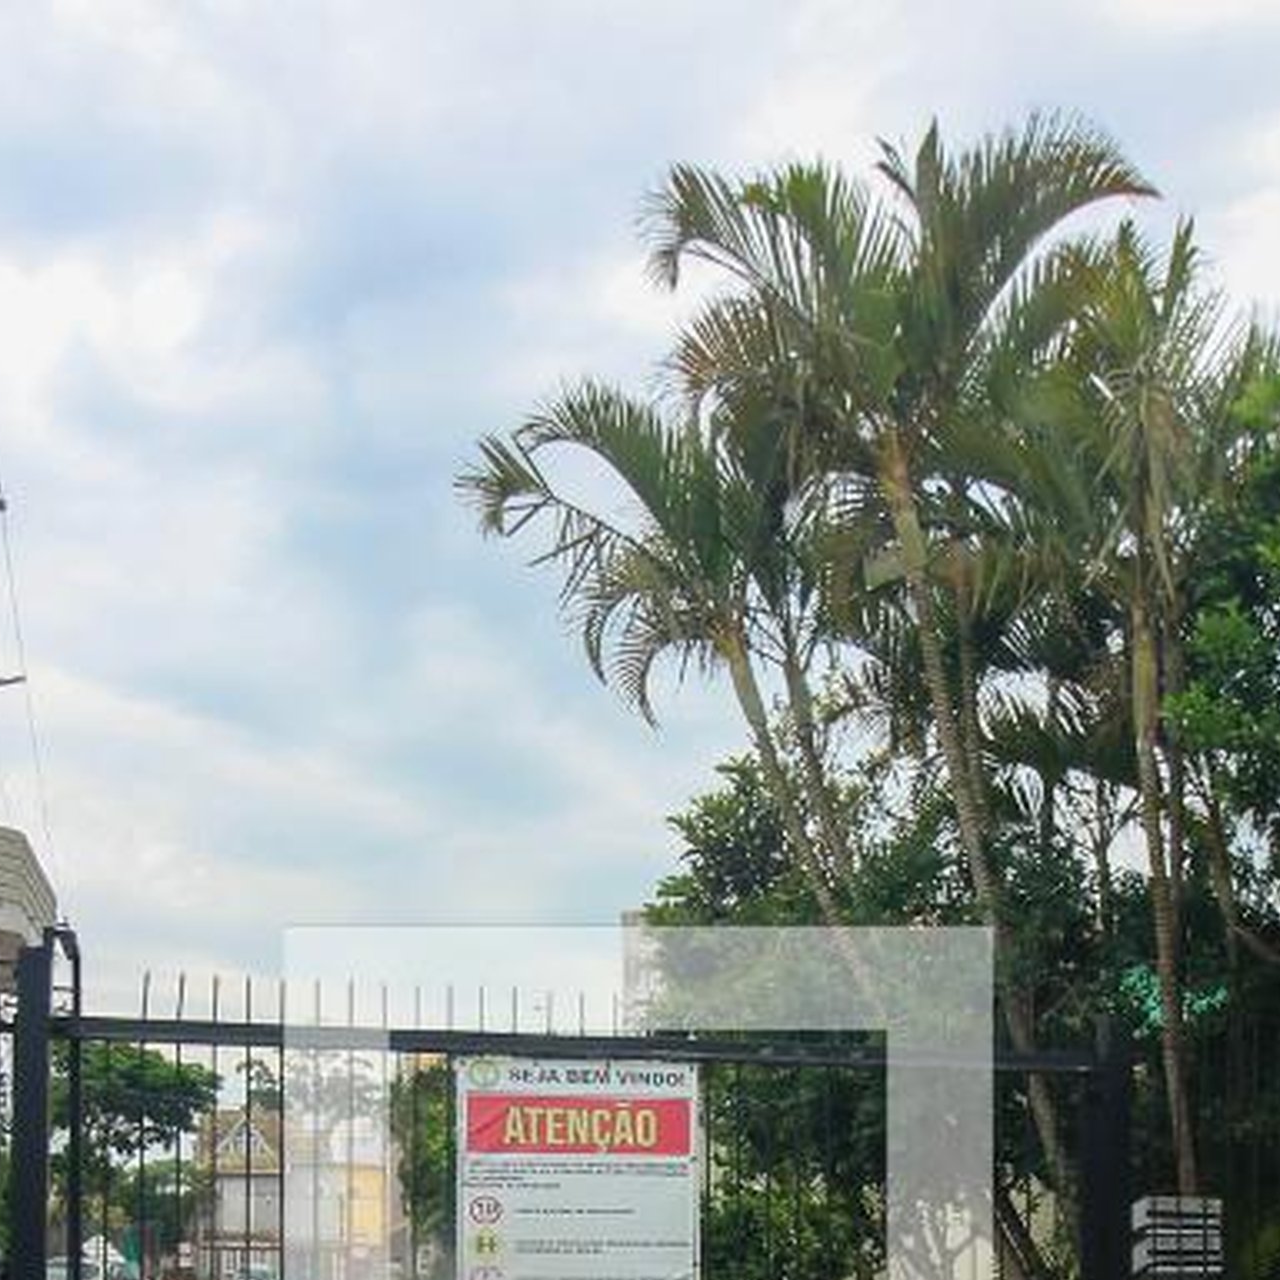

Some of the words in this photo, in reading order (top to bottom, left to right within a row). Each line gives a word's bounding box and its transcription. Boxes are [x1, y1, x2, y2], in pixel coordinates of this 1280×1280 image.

[508, 1067, 562, 1085] SEJA
[566, 1067, 611, 1086] BEM
[504, 1101, 658, 1153] ATENÇÃO
